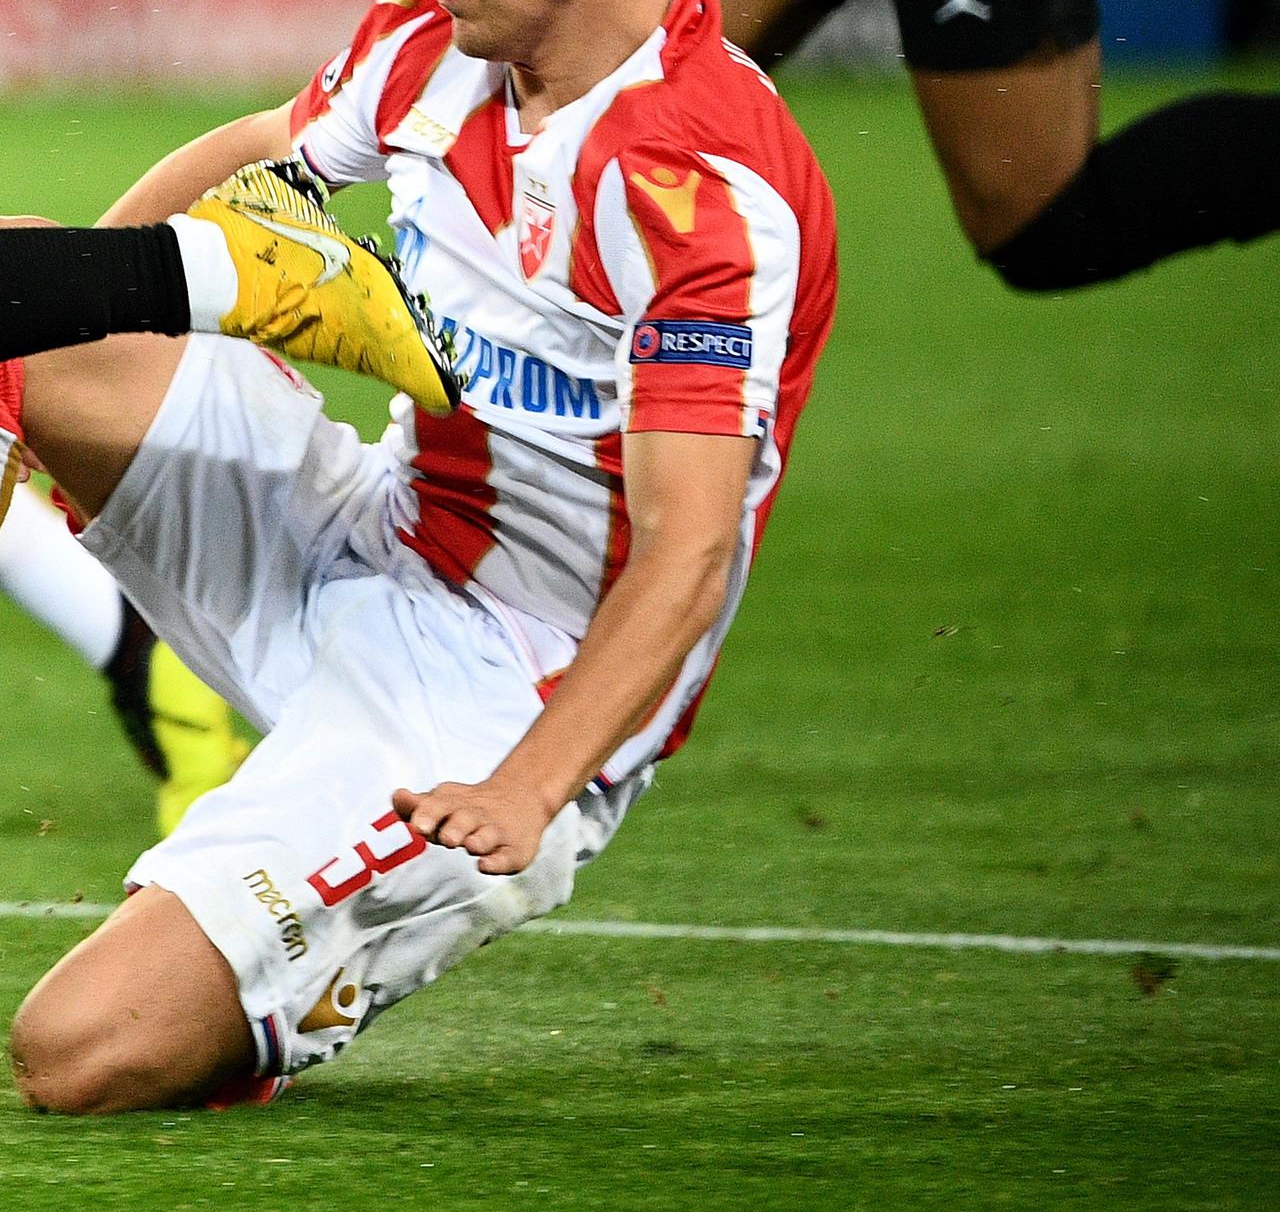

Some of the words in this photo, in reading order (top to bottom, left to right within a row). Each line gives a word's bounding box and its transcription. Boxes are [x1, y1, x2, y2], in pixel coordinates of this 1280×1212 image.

[661, 332, 752, 358] RESPECT
[306, 810, 427, 907] 3
[242, 868, 308, 962] macron
